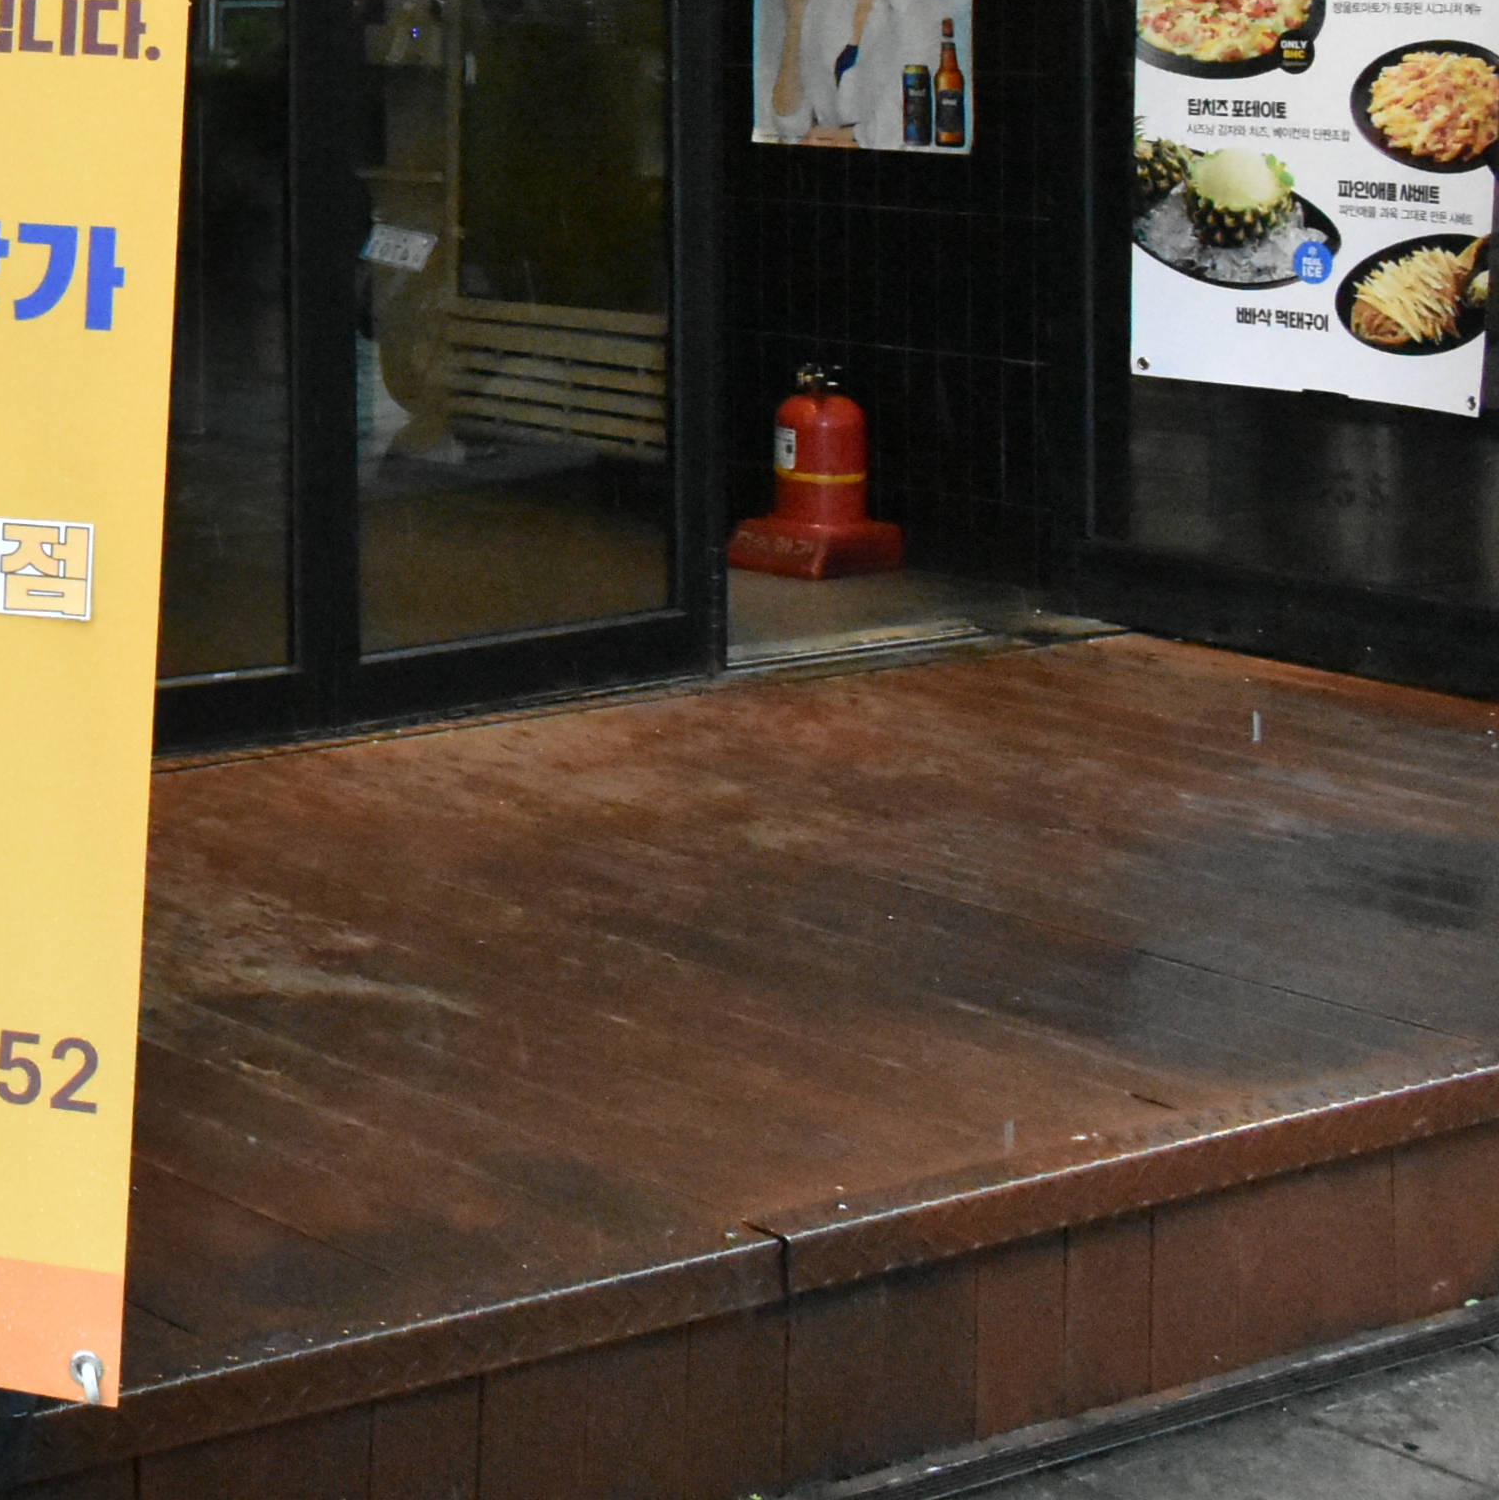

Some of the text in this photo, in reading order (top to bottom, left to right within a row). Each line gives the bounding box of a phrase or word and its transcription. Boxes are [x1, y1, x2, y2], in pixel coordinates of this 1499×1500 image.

[1187, 97, 1287, 119] 딥치즈 포테이토
[1337, 180, 1397, 203] 파인애플
[1302, 266, 1323, 278] ICE
[1275, 309, 1329, 333] 먹태구이
